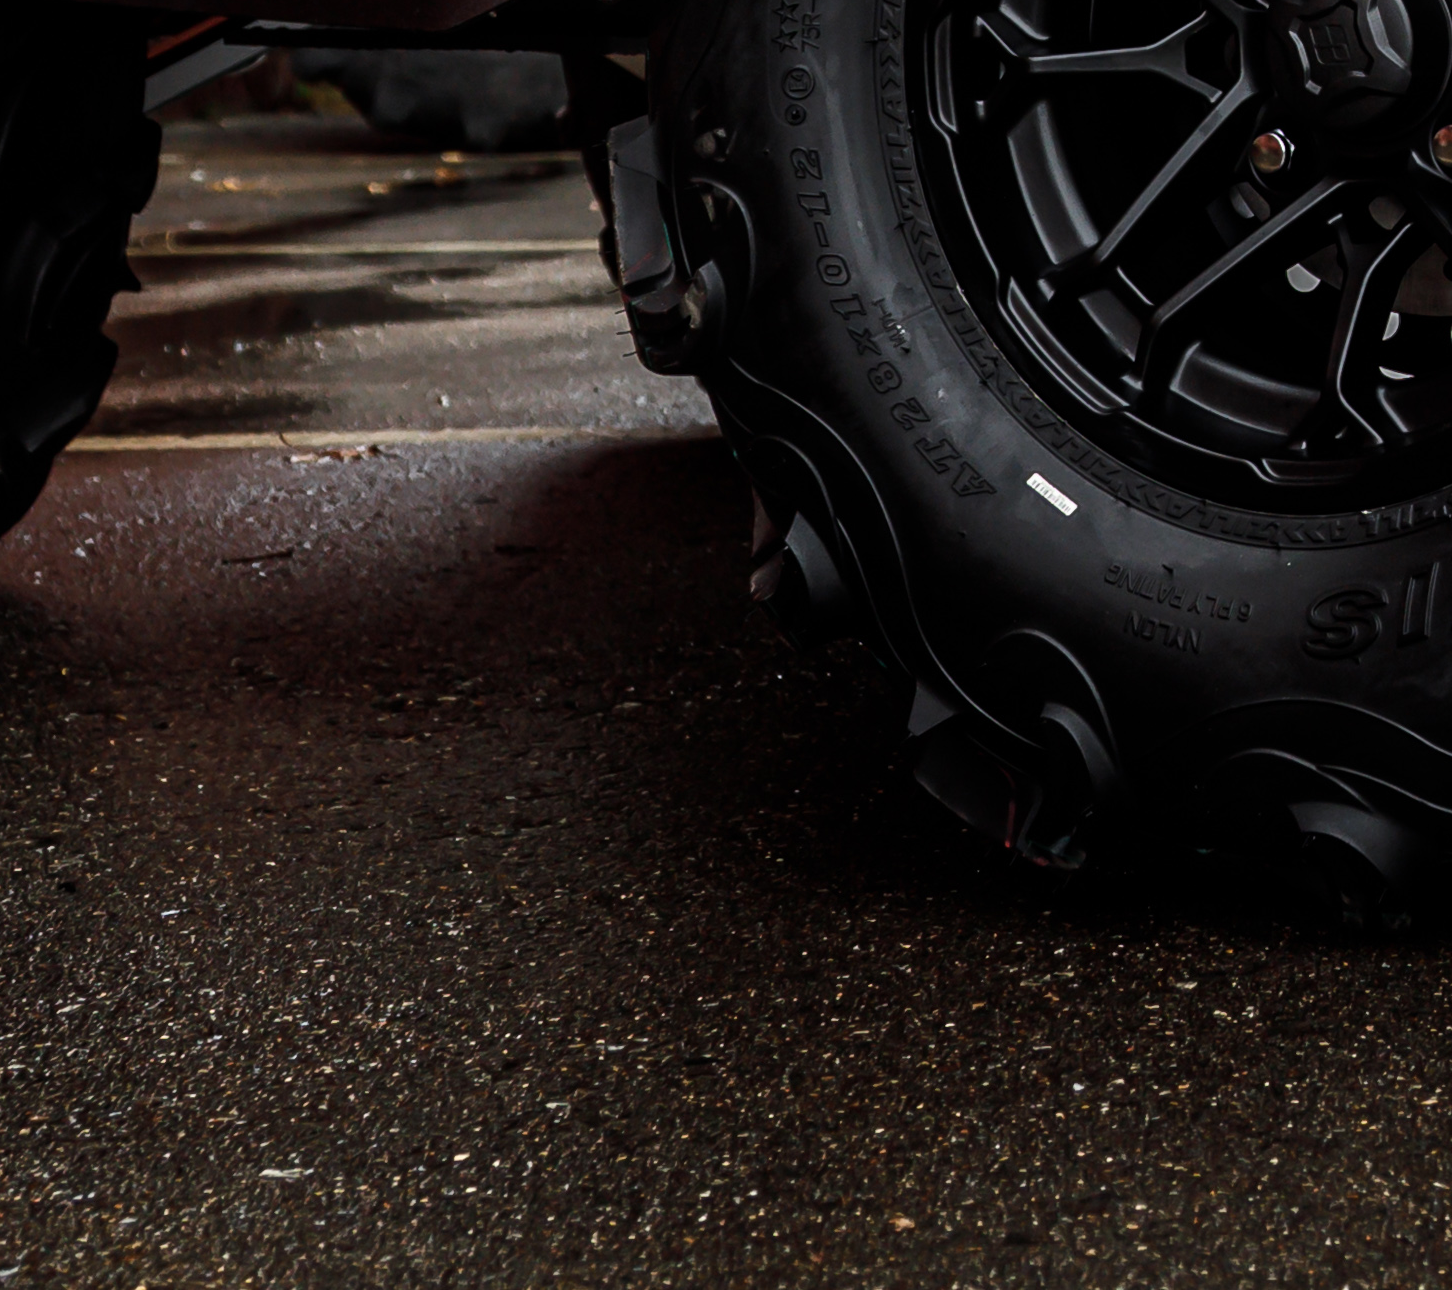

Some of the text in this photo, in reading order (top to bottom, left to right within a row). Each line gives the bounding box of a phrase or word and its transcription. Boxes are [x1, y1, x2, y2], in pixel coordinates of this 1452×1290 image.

[1104, 561, 1187, 612] RATING
[1188, 590, 1233, 620] PLY
[1124, 611, 1202, 656] NYLON
